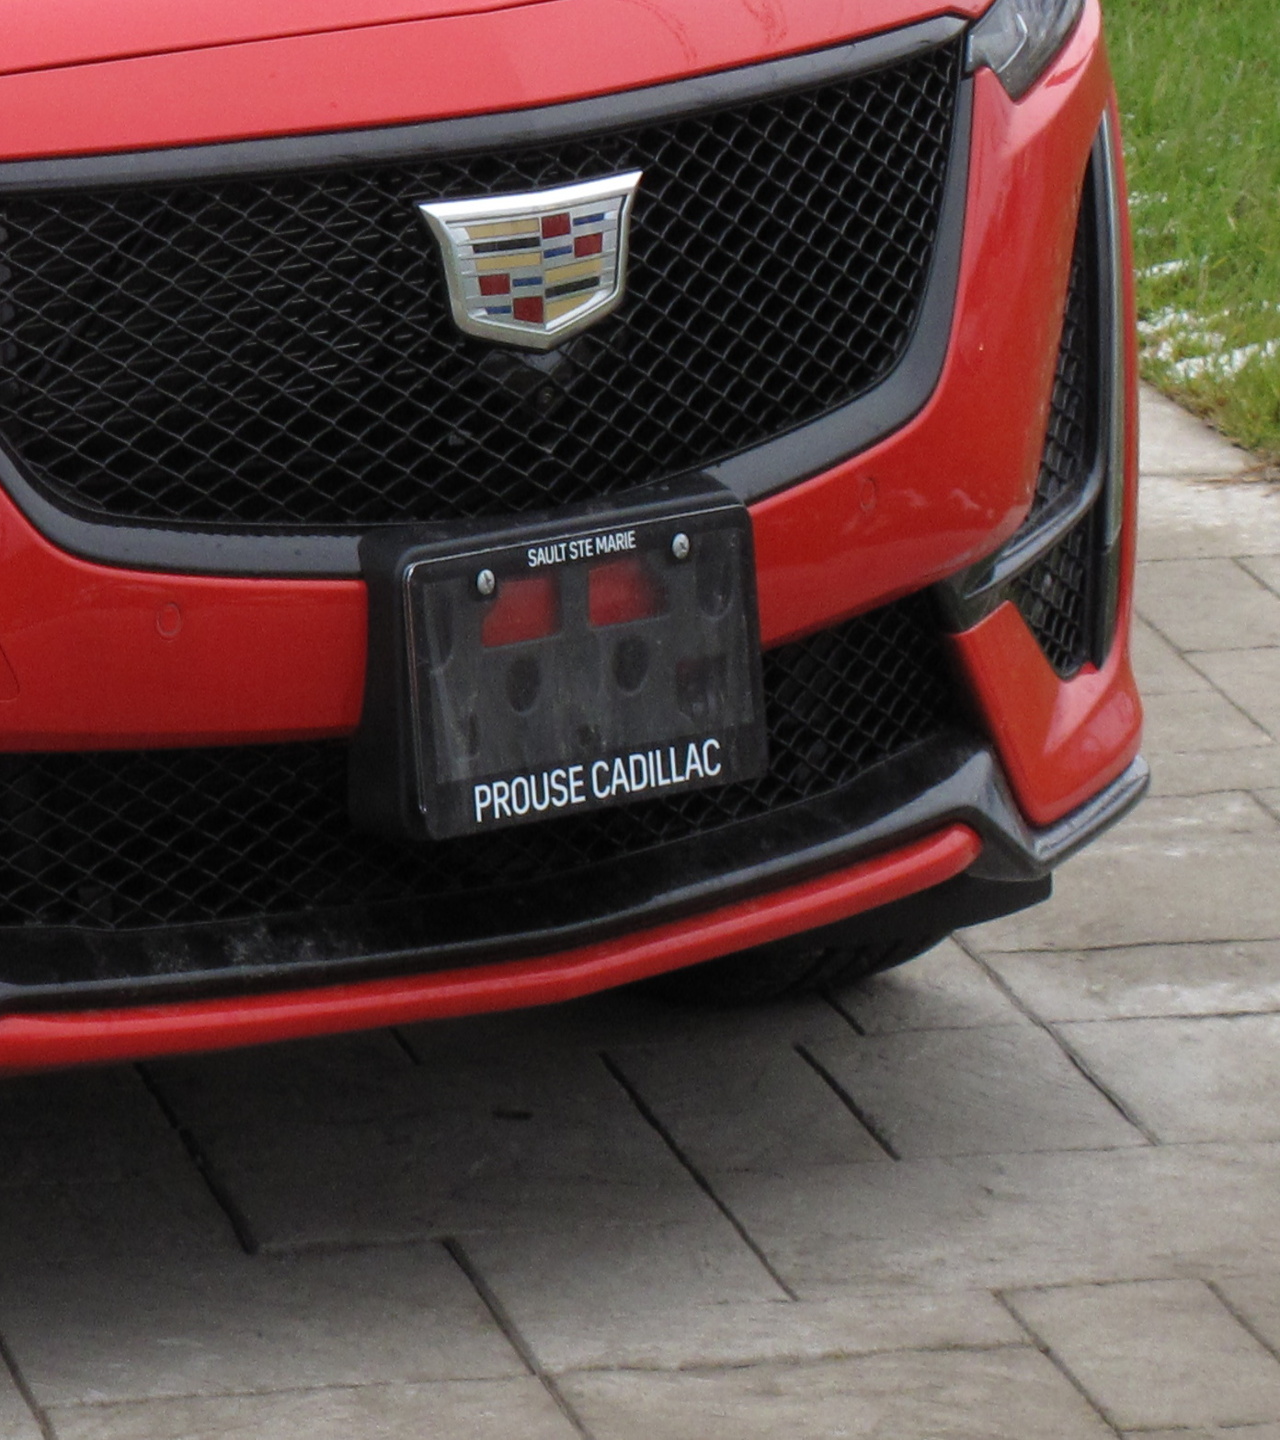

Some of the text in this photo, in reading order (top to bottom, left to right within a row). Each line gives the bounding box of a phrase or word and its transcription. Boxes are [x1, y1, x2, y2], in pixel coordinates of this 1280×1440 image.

[527, 530, 637, 568] SAULT STE MARIE
[474, 738, 722, 822] PROUSE CADILLAC
